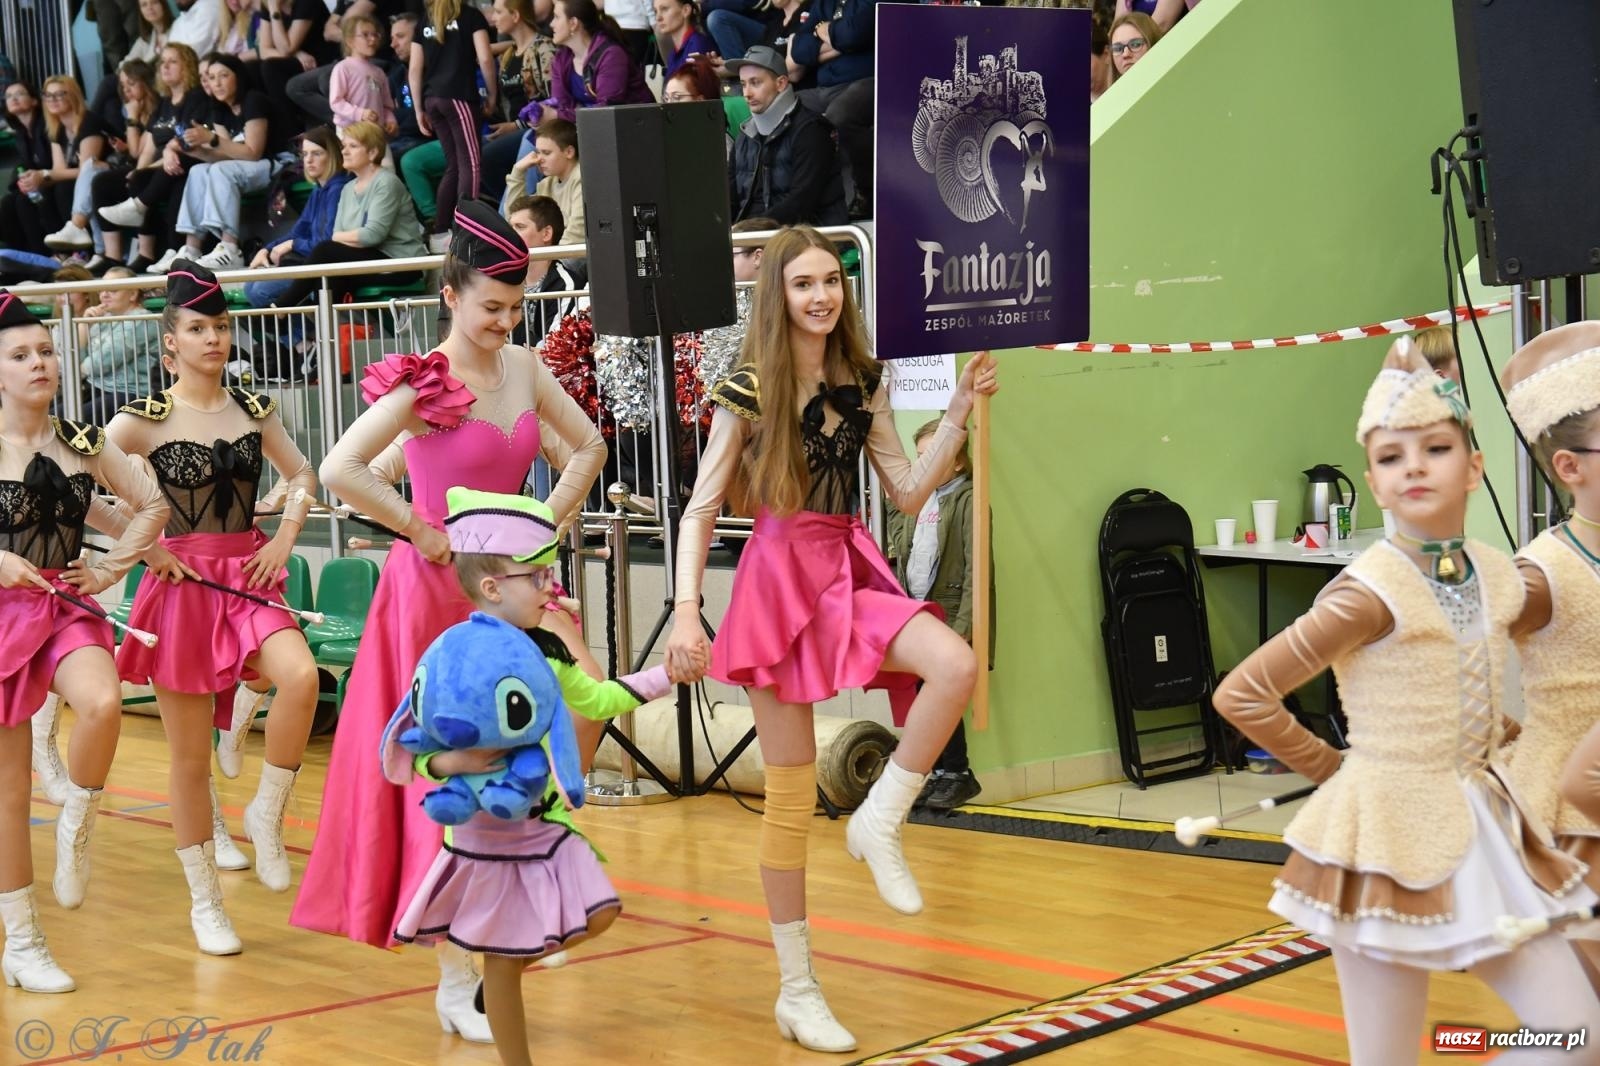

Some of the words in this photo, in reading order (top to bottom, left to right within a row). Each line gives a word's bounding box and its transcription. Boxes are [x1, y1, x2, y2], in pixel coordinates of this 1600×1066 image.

[915, 237, 1052, 306] Fantazja
[925, 315, 974, 332] ZESPÓŁ
[978, 309, 1051, 326] MAŻORETEK
[894, 378, 950, 391] MEDYCZNA
